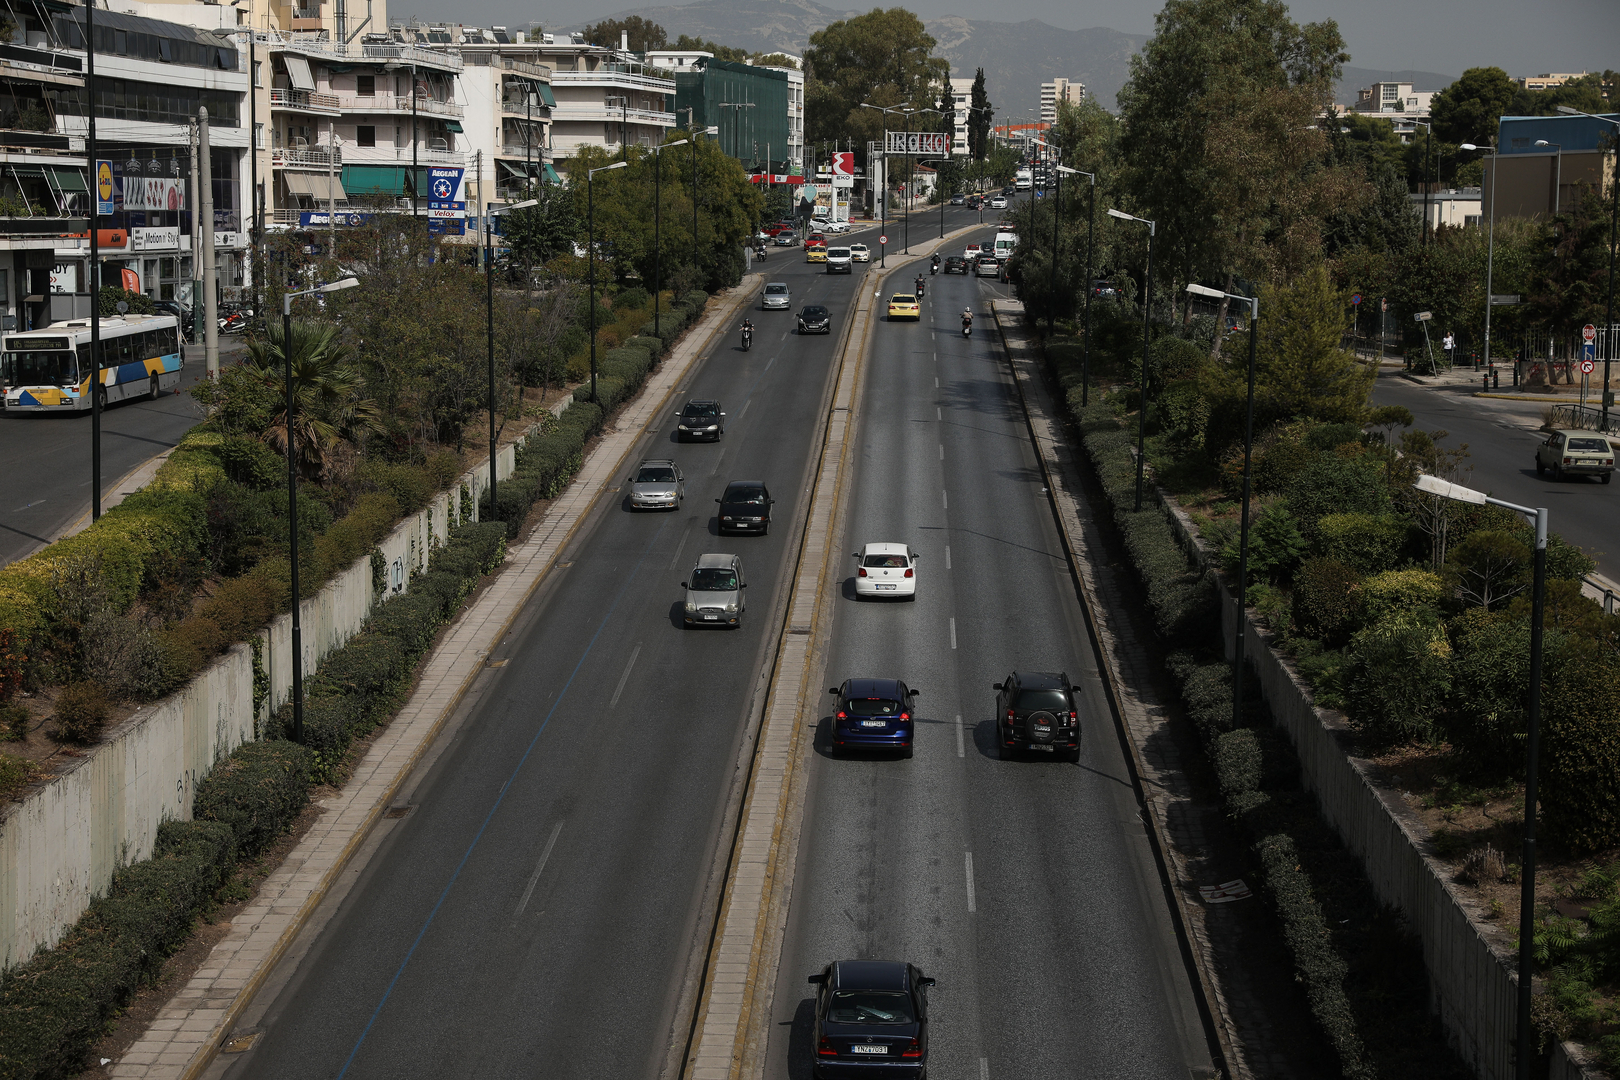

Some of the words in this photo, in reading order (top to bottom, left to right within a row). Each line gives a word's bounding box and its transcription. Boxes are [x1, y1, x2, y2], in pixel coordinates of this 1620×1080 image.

[146, 232, 162, 244] Motion
[168, 232, 179, 246] Stye
[1584, 328, 1595, 337] STOP
